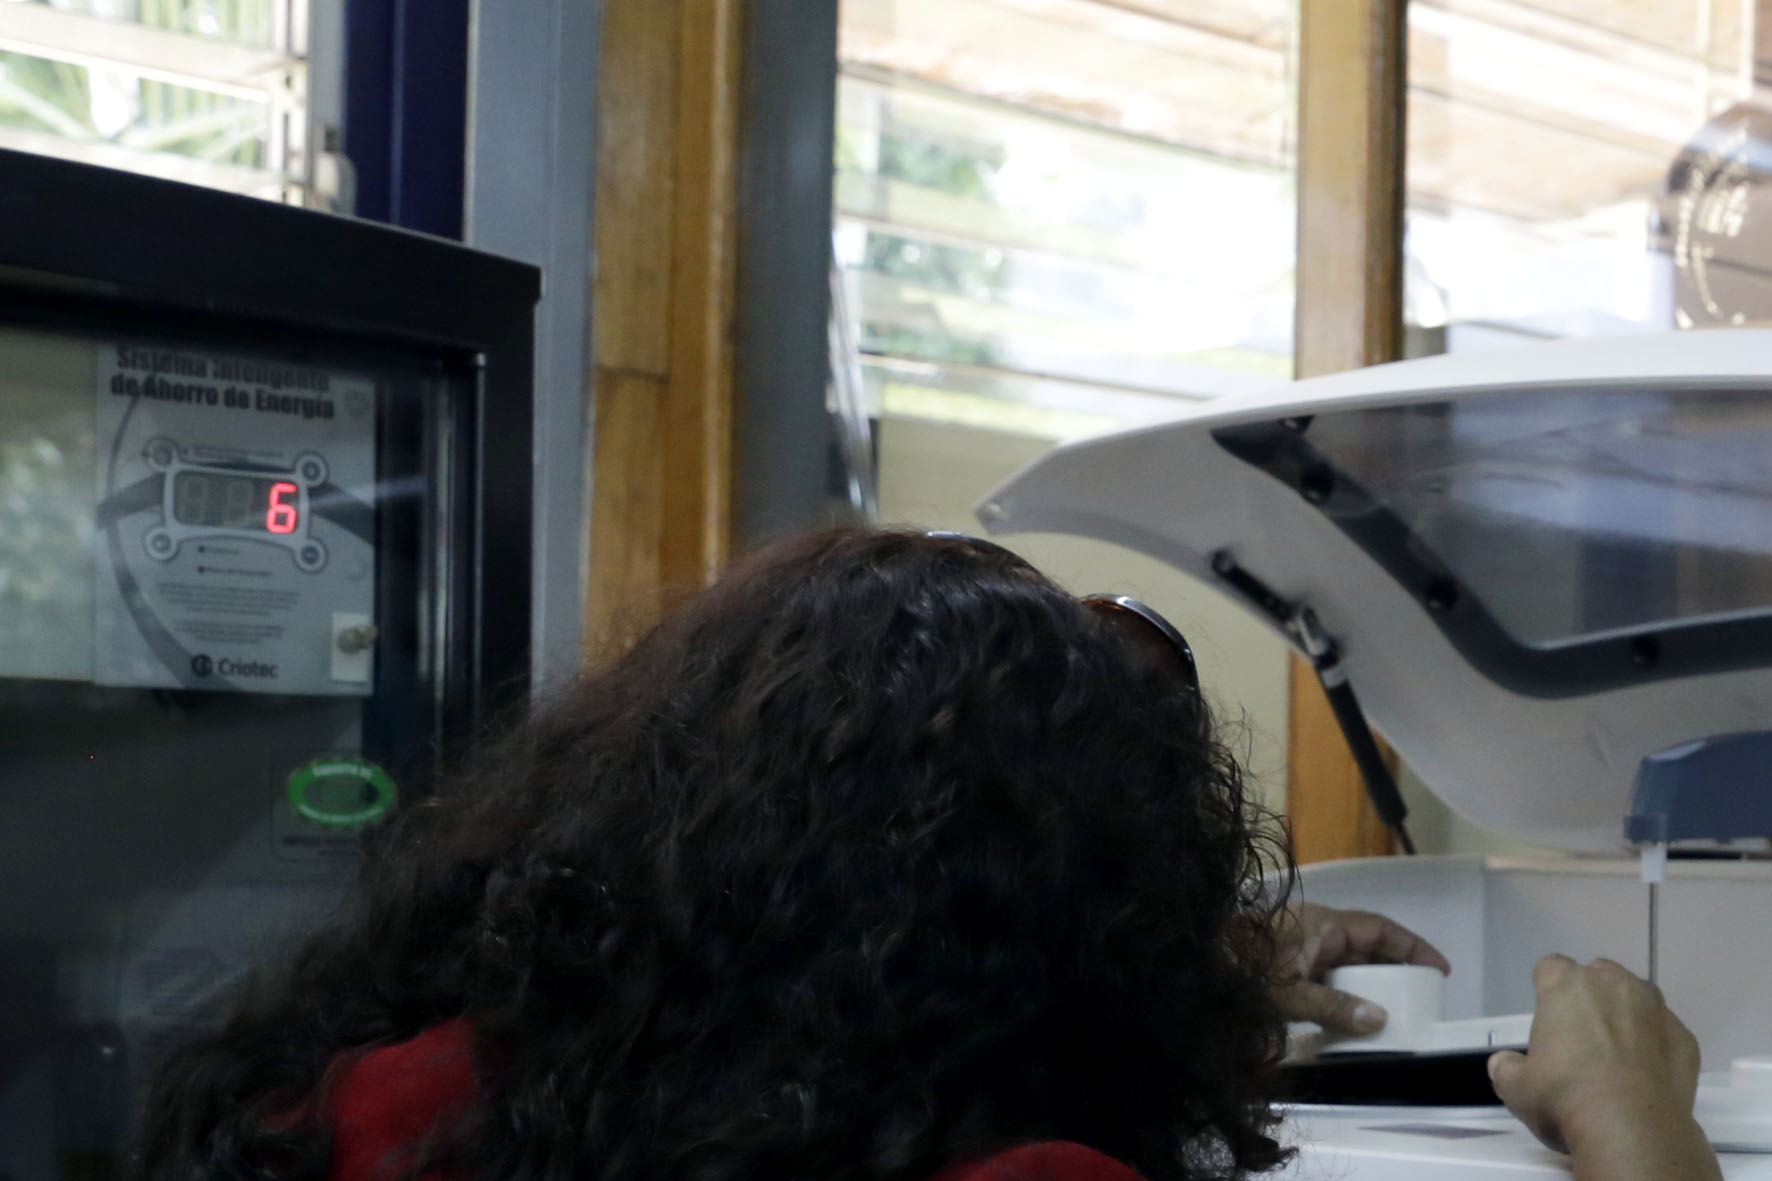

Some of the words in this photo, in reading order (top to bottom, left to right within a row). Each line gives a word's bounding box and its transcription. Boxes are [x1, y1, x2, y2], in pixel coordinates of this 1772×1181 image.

[111, 374, 139, 398] de
[224, 385, 251, 410] de
[265, 482, 299, 536] 6
[217, 659, 280, 681] Criotec
